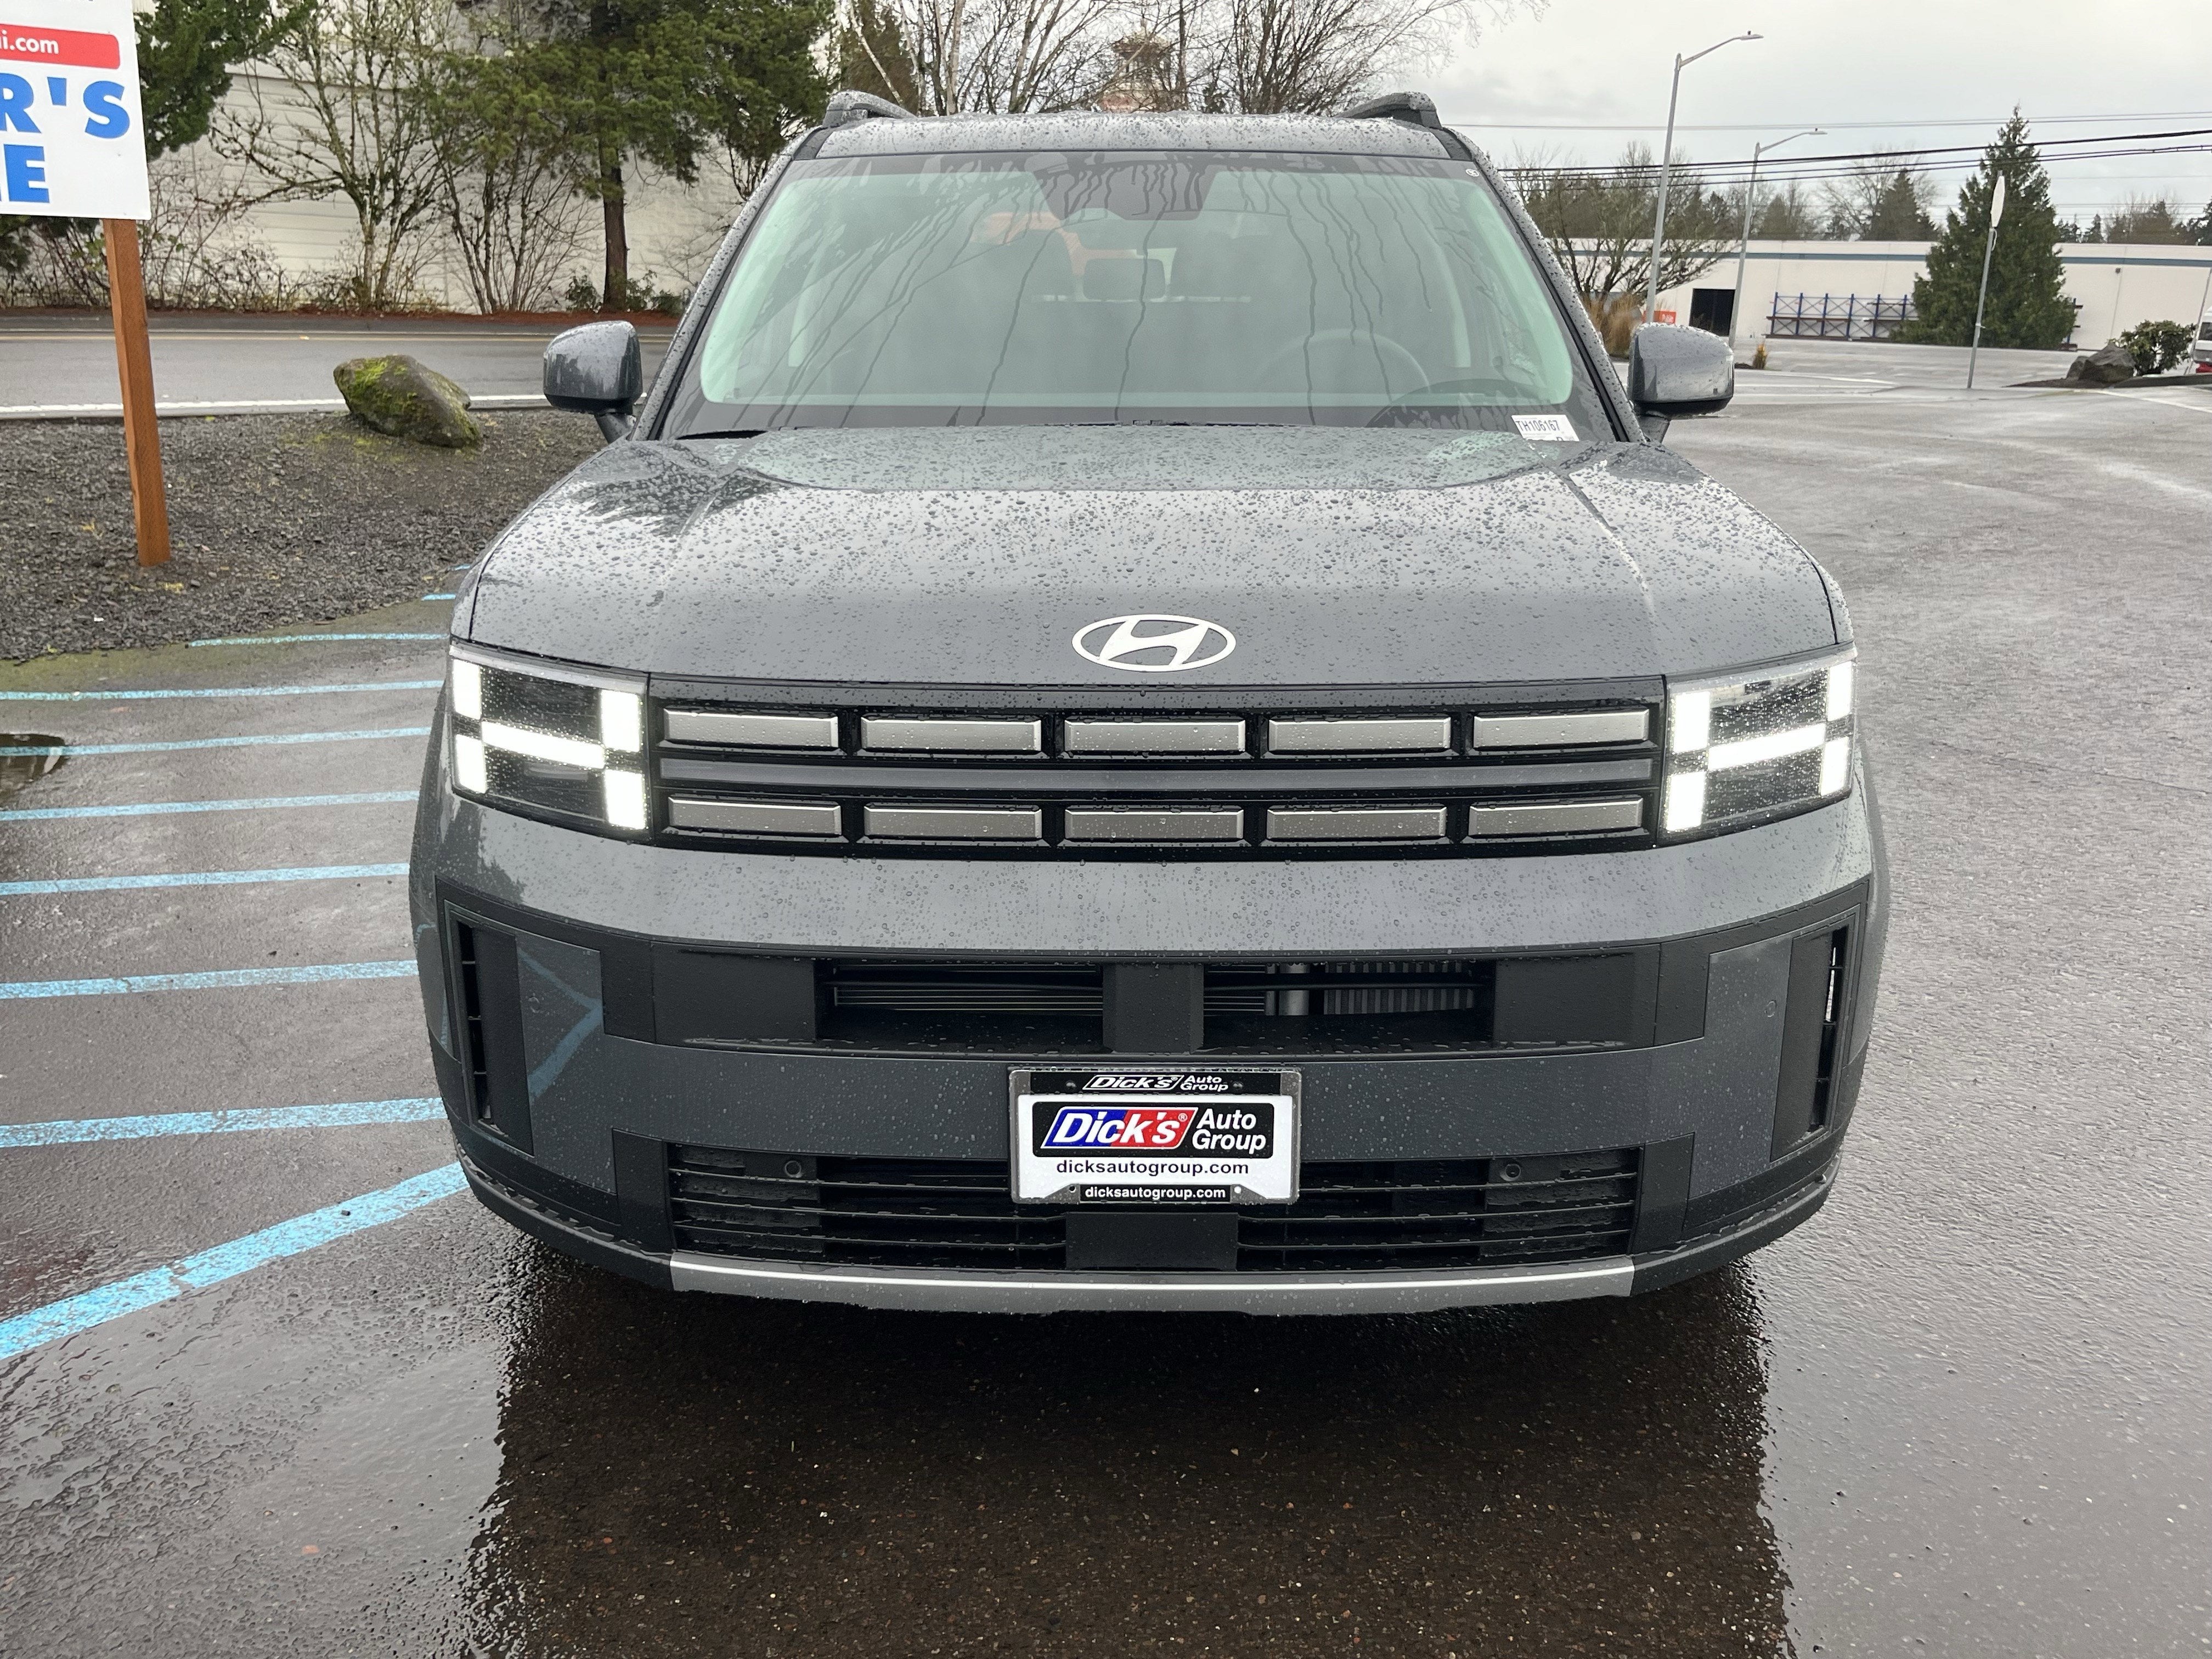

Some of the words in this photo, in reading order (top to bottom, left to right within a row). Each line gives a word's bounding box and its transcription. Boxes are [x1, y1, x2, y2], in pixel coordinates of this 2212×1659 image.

[0, 29, 59, 54] i.com
[0, 144, 50, 204] E
[1515, 420, 1560, 432] TH106167
[1090, 1076, 1172, 1088] Dick's
[1184, 1075, 1222, 1084] Auto
[1180, 1082, 1229, 1092] Group
[1052, 1111, 1181, 1144] Dick's
[1196, 1108, 1256, 1130] Auto
[1192, 1129, 1267, 1154] Group
[1056, 1160, 1249, 1176] dicksautogroup.com
[1085, 1186, 1226, 1199] dicksautogroup.com
